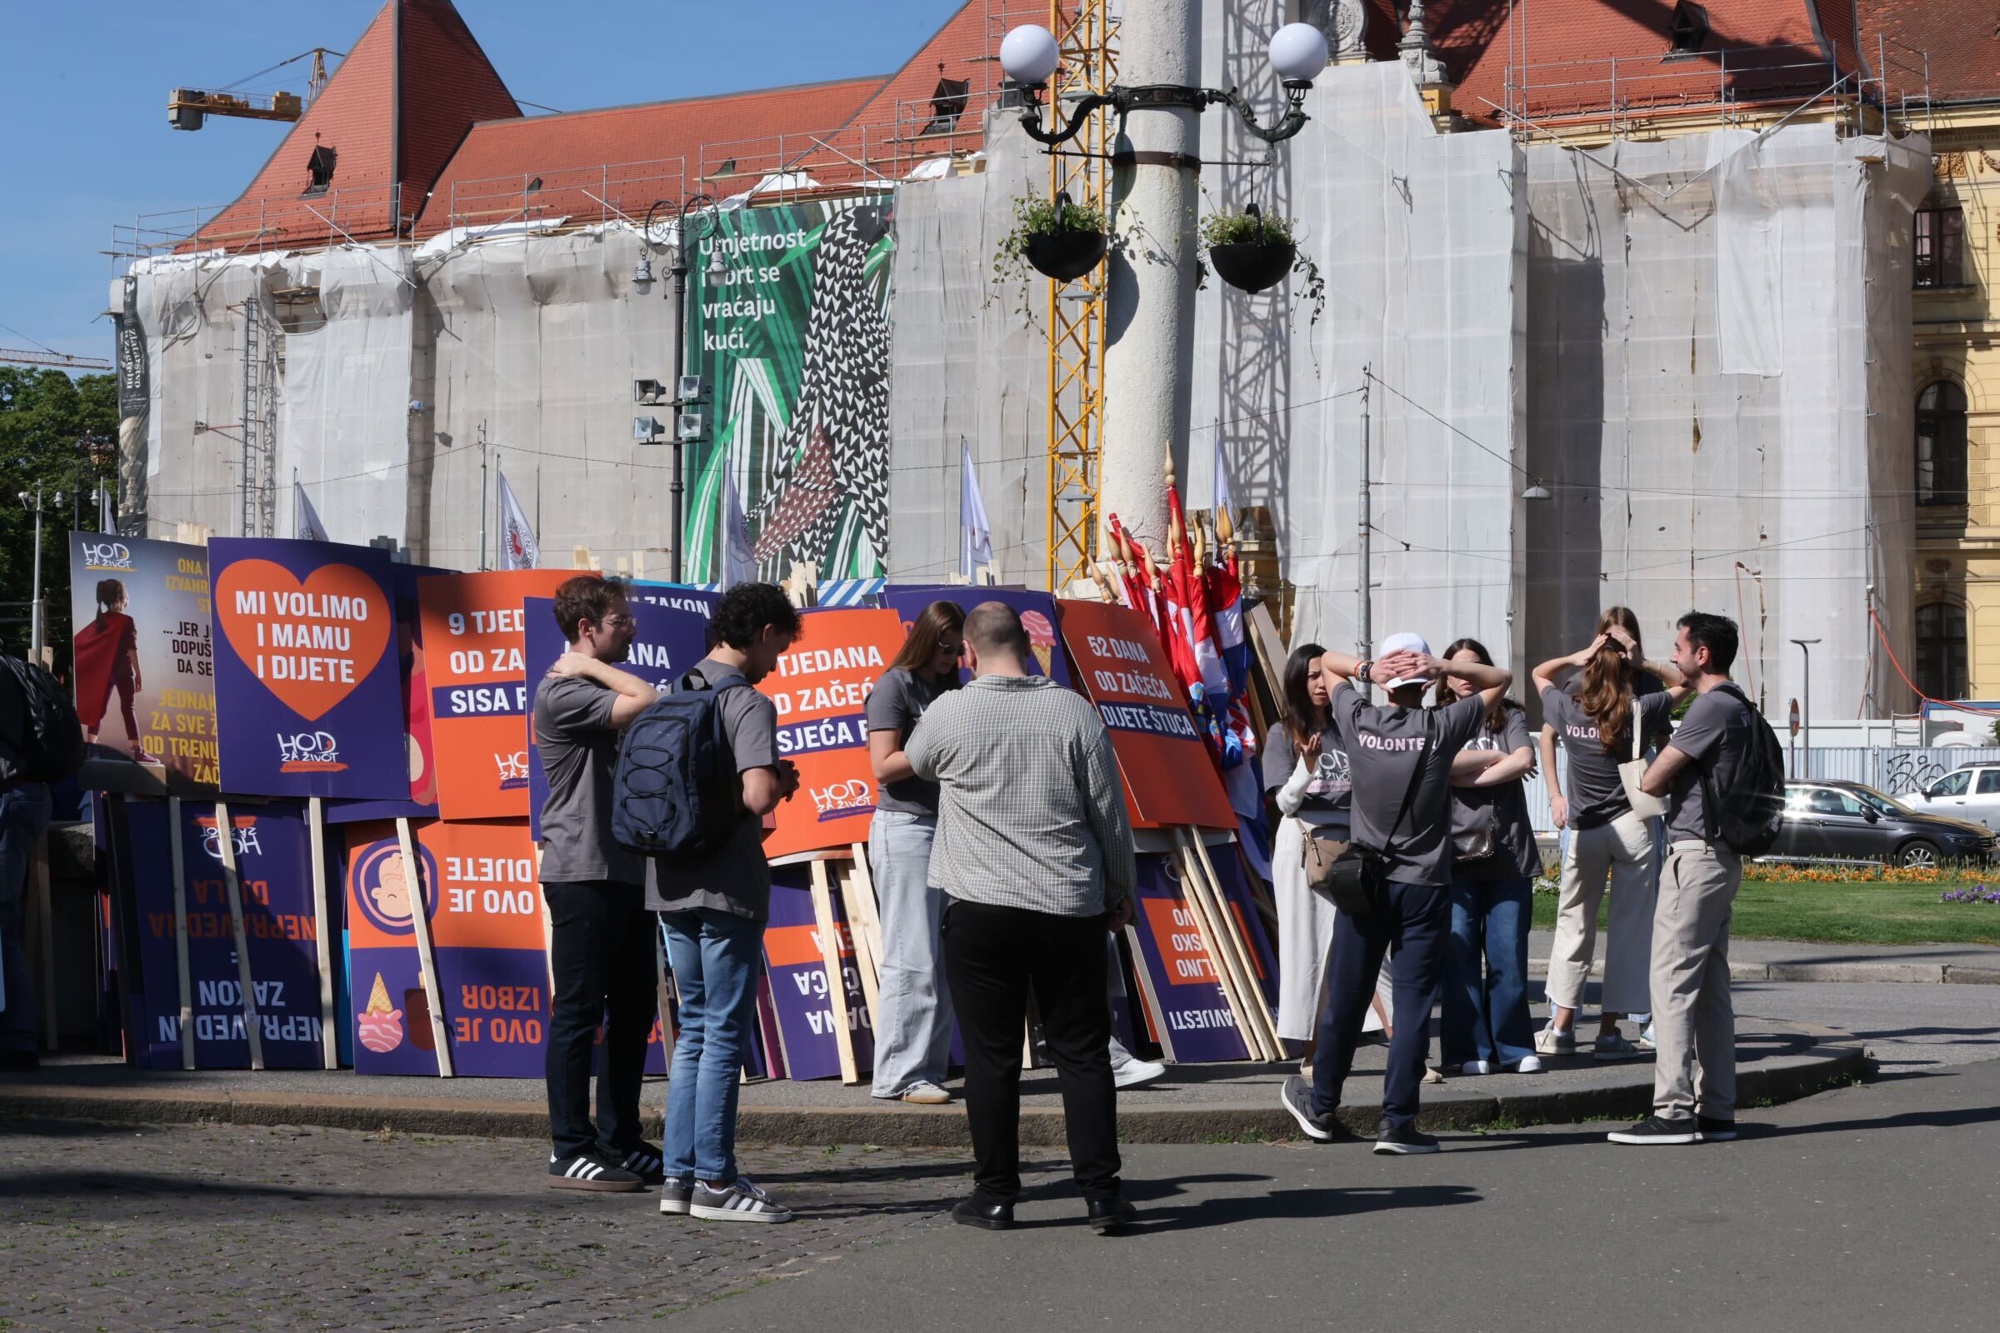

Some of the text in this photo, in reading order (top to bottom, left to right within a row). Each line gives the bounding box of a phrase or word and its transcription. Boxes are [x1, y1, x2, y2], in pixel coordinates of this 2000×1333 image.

[759, 266, 780, 283] se
[702, 293, 776, 321] vraćaju
[704, 327, 749, 351] kući.
[82, 542, 130, 562] HOD
[85, 557, 133, 569] ZA ŽIVOT
[178, 558, 203, 576] ONA
[235, 590, 368, 622] MI VOLIMO
[177, 621, 199, 638] JER
[257, 623, 351, 651] I MAMU
[448, 612, 465, 636] 9
[450, 648, 525, 675] OD ZA
[777, 645, 885, 678] TJEDANA
[1087, 636, 1150, 664] 52 DANA
[177, 659, 213, 677] DA SE
[257, 654, 355, 684] I DIJETE
[1094, 669, 1173, 700] OD ZAČEĆA
[450, 687, 510, 714] SISA
[151, 711, 171, 731] ZA
[176, 714, 205, 735] SVE
[1100, 704, 1197, 737] DIJETE ŠTUCA
[142, 735, 164, 755] OD
[277, 731, 337, 754] HOD
[776, 718, 855, 753] SJEĆA
[1358, 734, 1436, 751] VOLONTE
[281, 751, 340, 763] ZA ŽIVOT
[500, 767, 518, 780] ZA
[809, 779, 869, 806] HOD
[817, 801, 834, 813] ZA
[837, 795, 874, 810] ŽIVOT
[446, 857, 532, 883] DIJETE
[191, 879, 270, 906] DJLA
[448, 888, 535, 915] OVO JE
[461, 984, 540, 1011] IZBOR
[158, 1014, 324, 1042] NEPRVEDN
[454, 1017, 542, 1044] OVO JE
